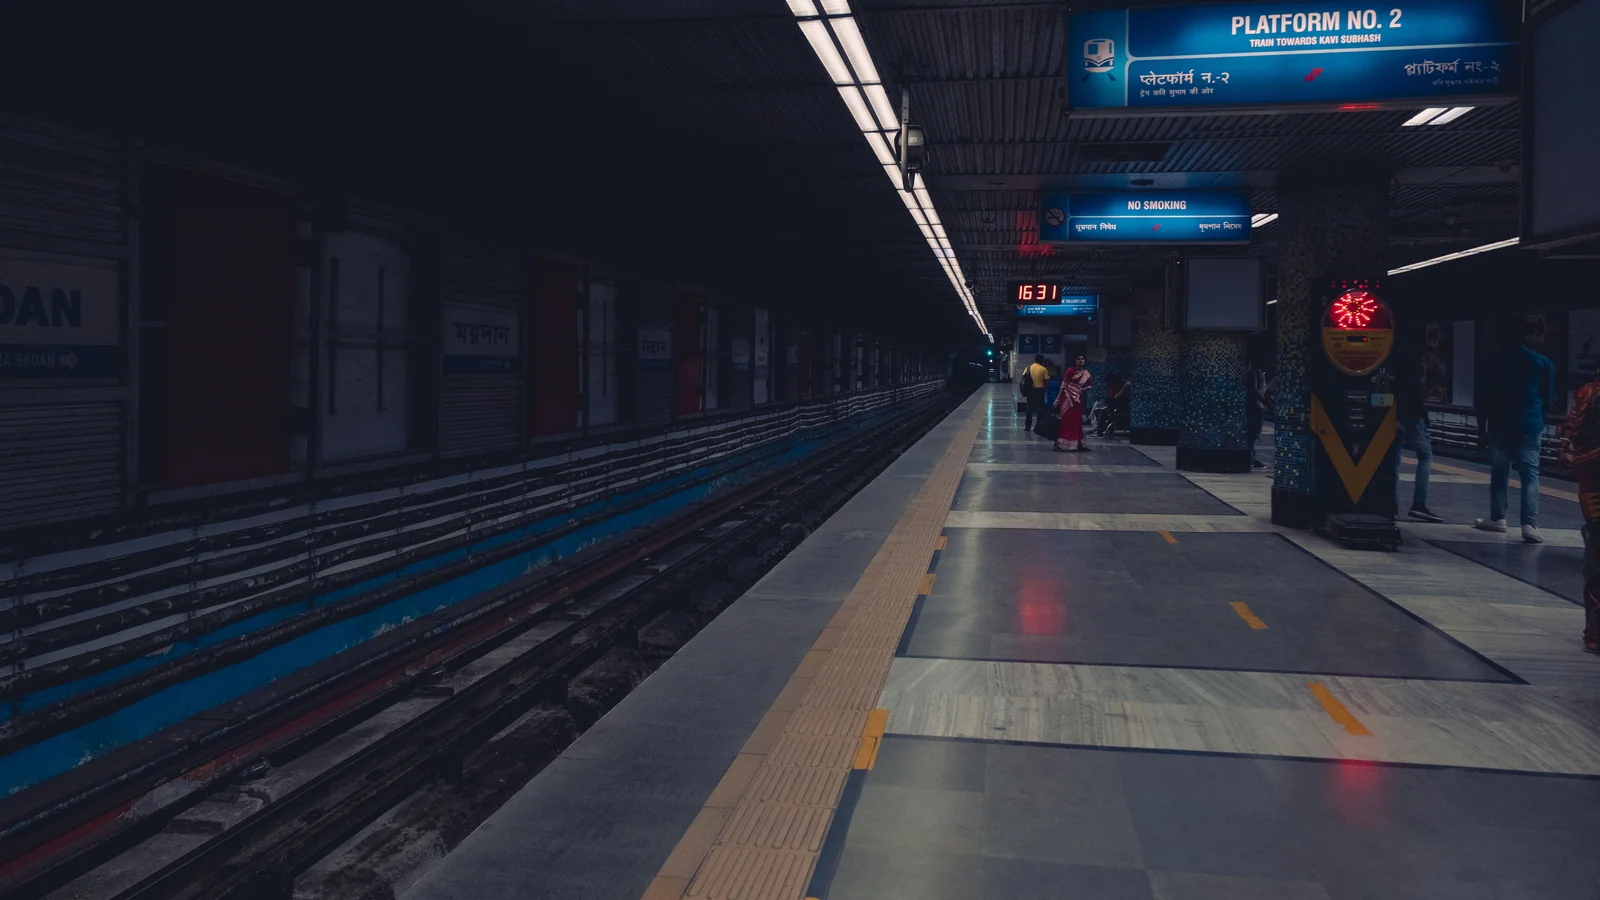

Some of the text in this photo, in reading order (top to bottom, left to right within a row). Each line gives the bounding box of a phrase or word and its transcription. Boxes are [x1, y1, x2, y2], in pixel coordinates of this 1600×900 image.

[1231, 8, 1403, 35] PLATFORM NO. 2
[1249, 33, 1381, 48] TRAIN TOWARDS KAVI SUBHASH
[1139, 69, 1195, 86] प्लेटफॉर्म
[1127, 200, 1187, 210] NO SMOKING
[14, 352, 55, 367] SADAN
